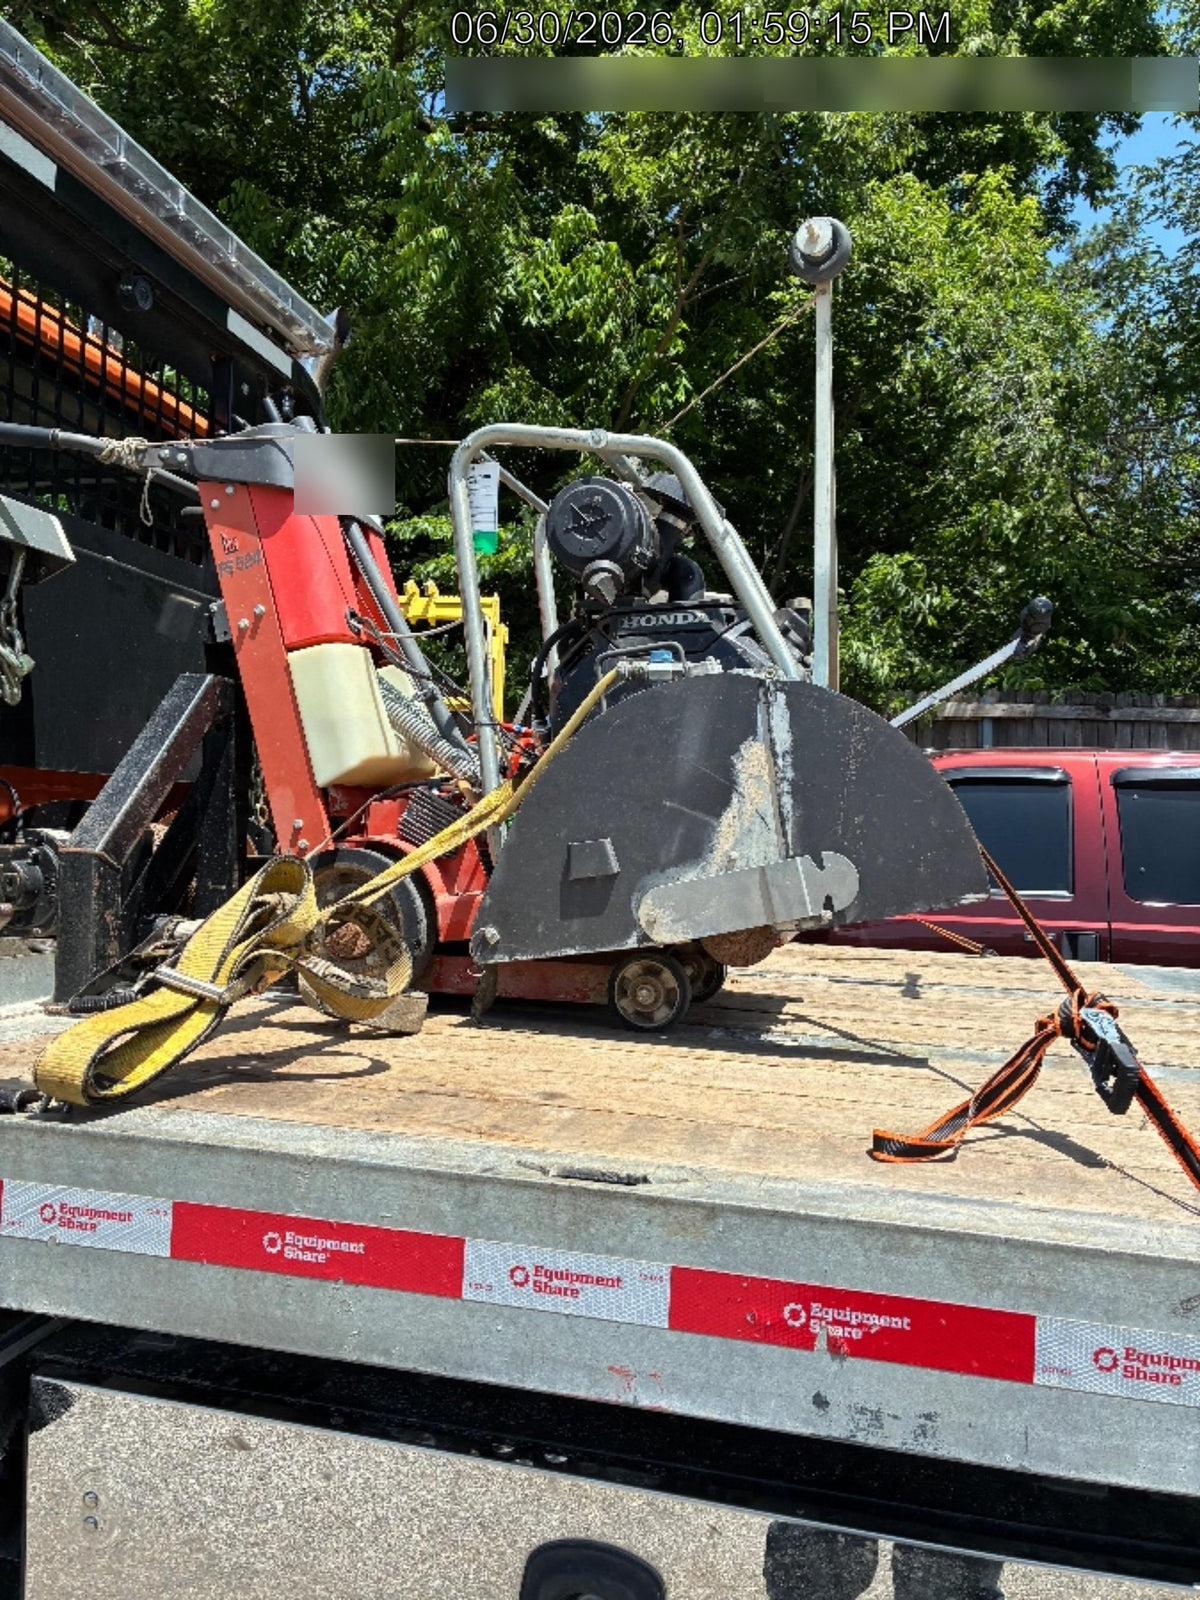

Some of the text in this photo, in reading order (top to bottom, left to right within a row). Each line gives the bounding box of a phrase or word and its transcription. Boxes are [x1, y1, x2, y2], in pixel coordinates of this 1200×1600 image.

[622, 612, 713, 629] HONDA
[59, 1203, 133, 1222] Equipment
[57, 1216, 98, 1232] Share
[284, 1231, 366, 1254] Equipment
[283, 1246, 327, 1263] Share
[533, 1265, 623, 1288] Equipment
[532, 1280, 581, 1299] Share
[810, 1302, 912, 1330] Equipment
[1122, 1364, 1182, 1386] Share
